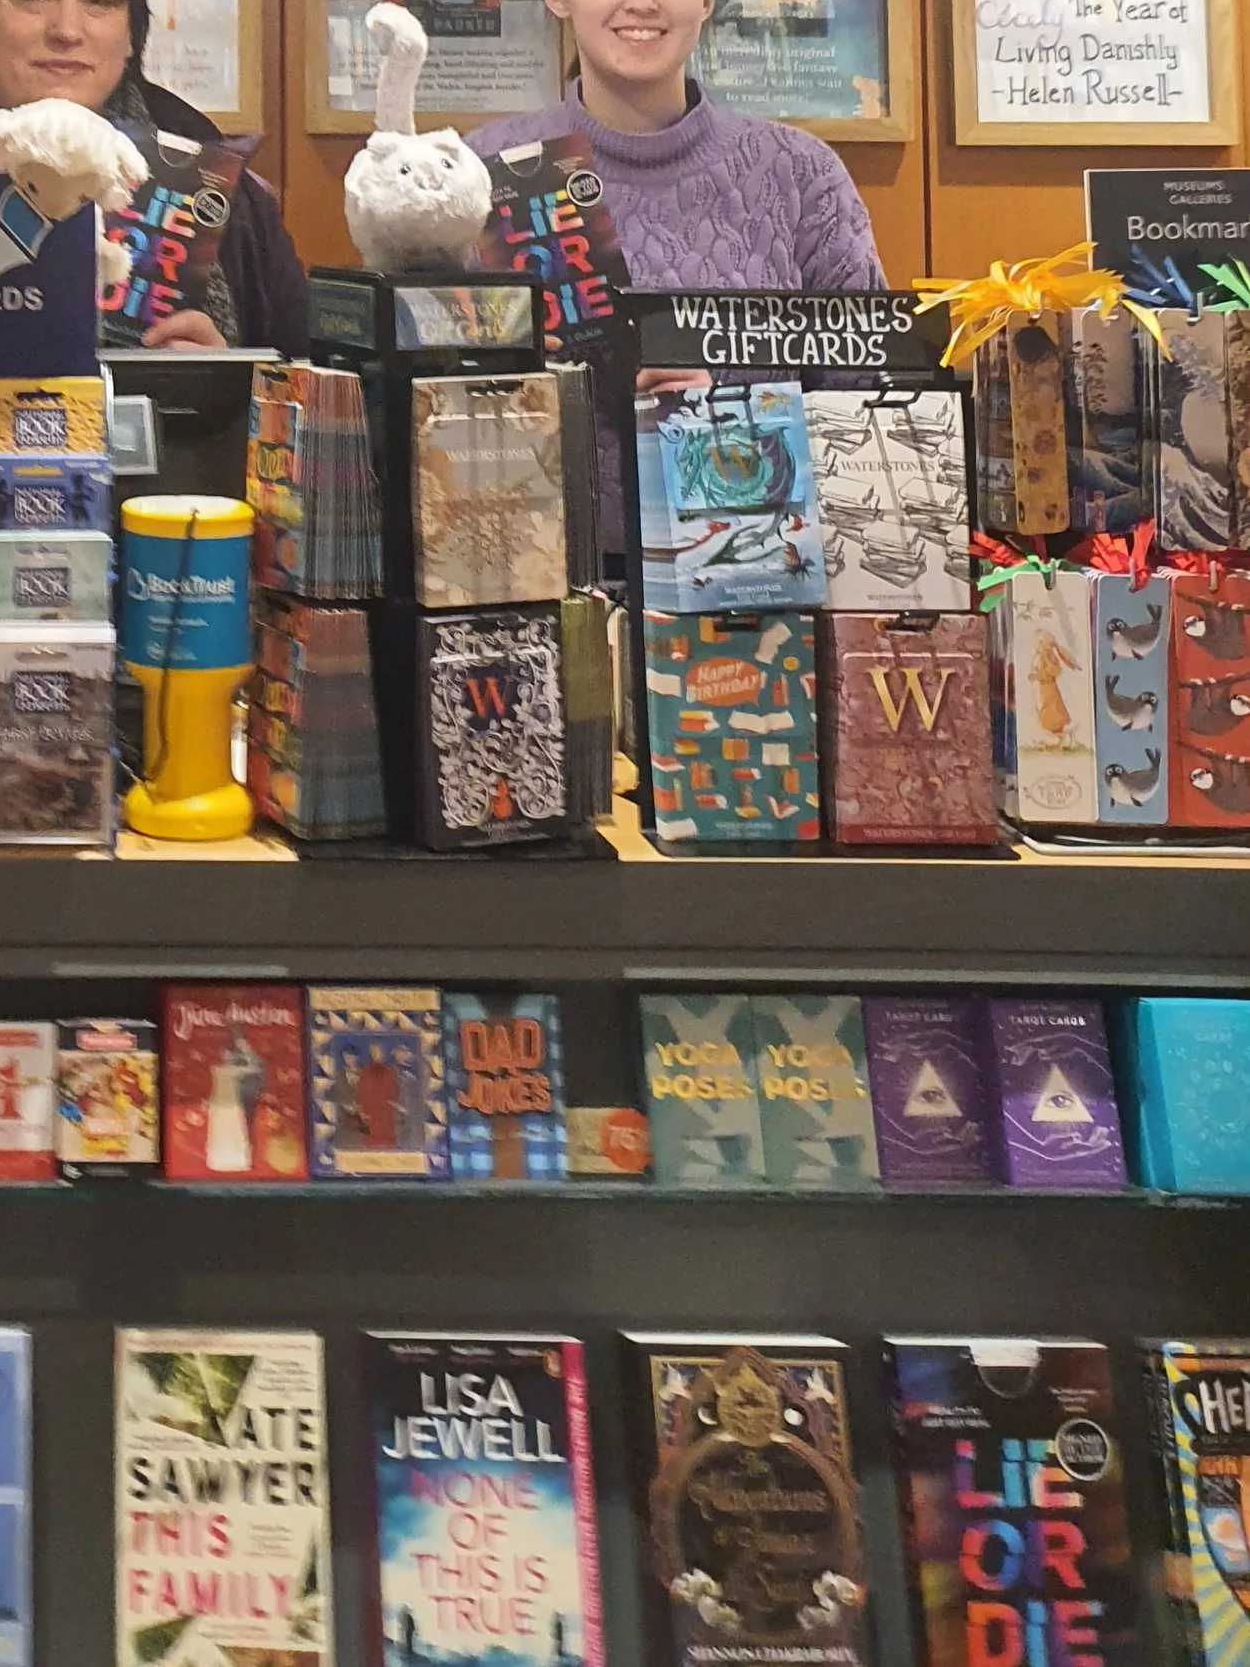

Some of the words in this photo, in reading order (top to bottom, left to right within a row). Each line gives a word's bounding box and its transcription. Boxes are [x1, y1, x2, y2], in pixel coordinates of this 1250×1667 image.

[995, 34, 1073, 77] Living
[1078, 32, 1180, 70] Danishly
[1163, 180, 1225, 191] MUSEUMS
[1168, 194, 1232, 205] GALLERIES
[498, 189, 585, 245] LIE
[512, 234, 593, 283] OR
[672, 295, 914, 334] WATERSTONES
[702, 330, 888, 367] GIFTCARDS
[444, 446, 539, 463] WATERSTONES
[841, 460, 937, 473] WATERSTONES
[690, 675, 765, 701] BIRTHDAY
[695, 660, 746, 684] HAPPY
[464, 676, 510, 719] W
[867, 666, 959, 733] W
[173, 1003, 226, 1041] Jane
[1009, 1014, 1047, 1026] TAROT
[1047, 1014, 1088, 1027] CARDS
[459, 1018, 544, 1071] DAD
[654, 1039, 742, 1070] YOGA
[766, 1042, 852, 1070] YOGA
[456, 1070, 552, 1116] JOKES
[650, 1073, 754, 1102] POSES
[419, 1372, 524, 1417] LISA
[381, 1416, 568, 1463] JEWELL
[127, 1457, 319, 1508] SAWYER
[410, 1471, 540, 1511] NONE
[954, 1438, 1085, 1509] LIE
[127, 1510, 232, 1558] THIS
[449, 1511, 509, 1551] OF
[410, 1552, 502, 1594] THIS
[513, 1554, 548, 1595] IS
[958, 1519, 1087, 1592] OR
[127, 1568, 293, 1620] FAMILY
[429, 1594, 539, 1637] TRUE
[966, 1600, 1106, 1667] DIE
